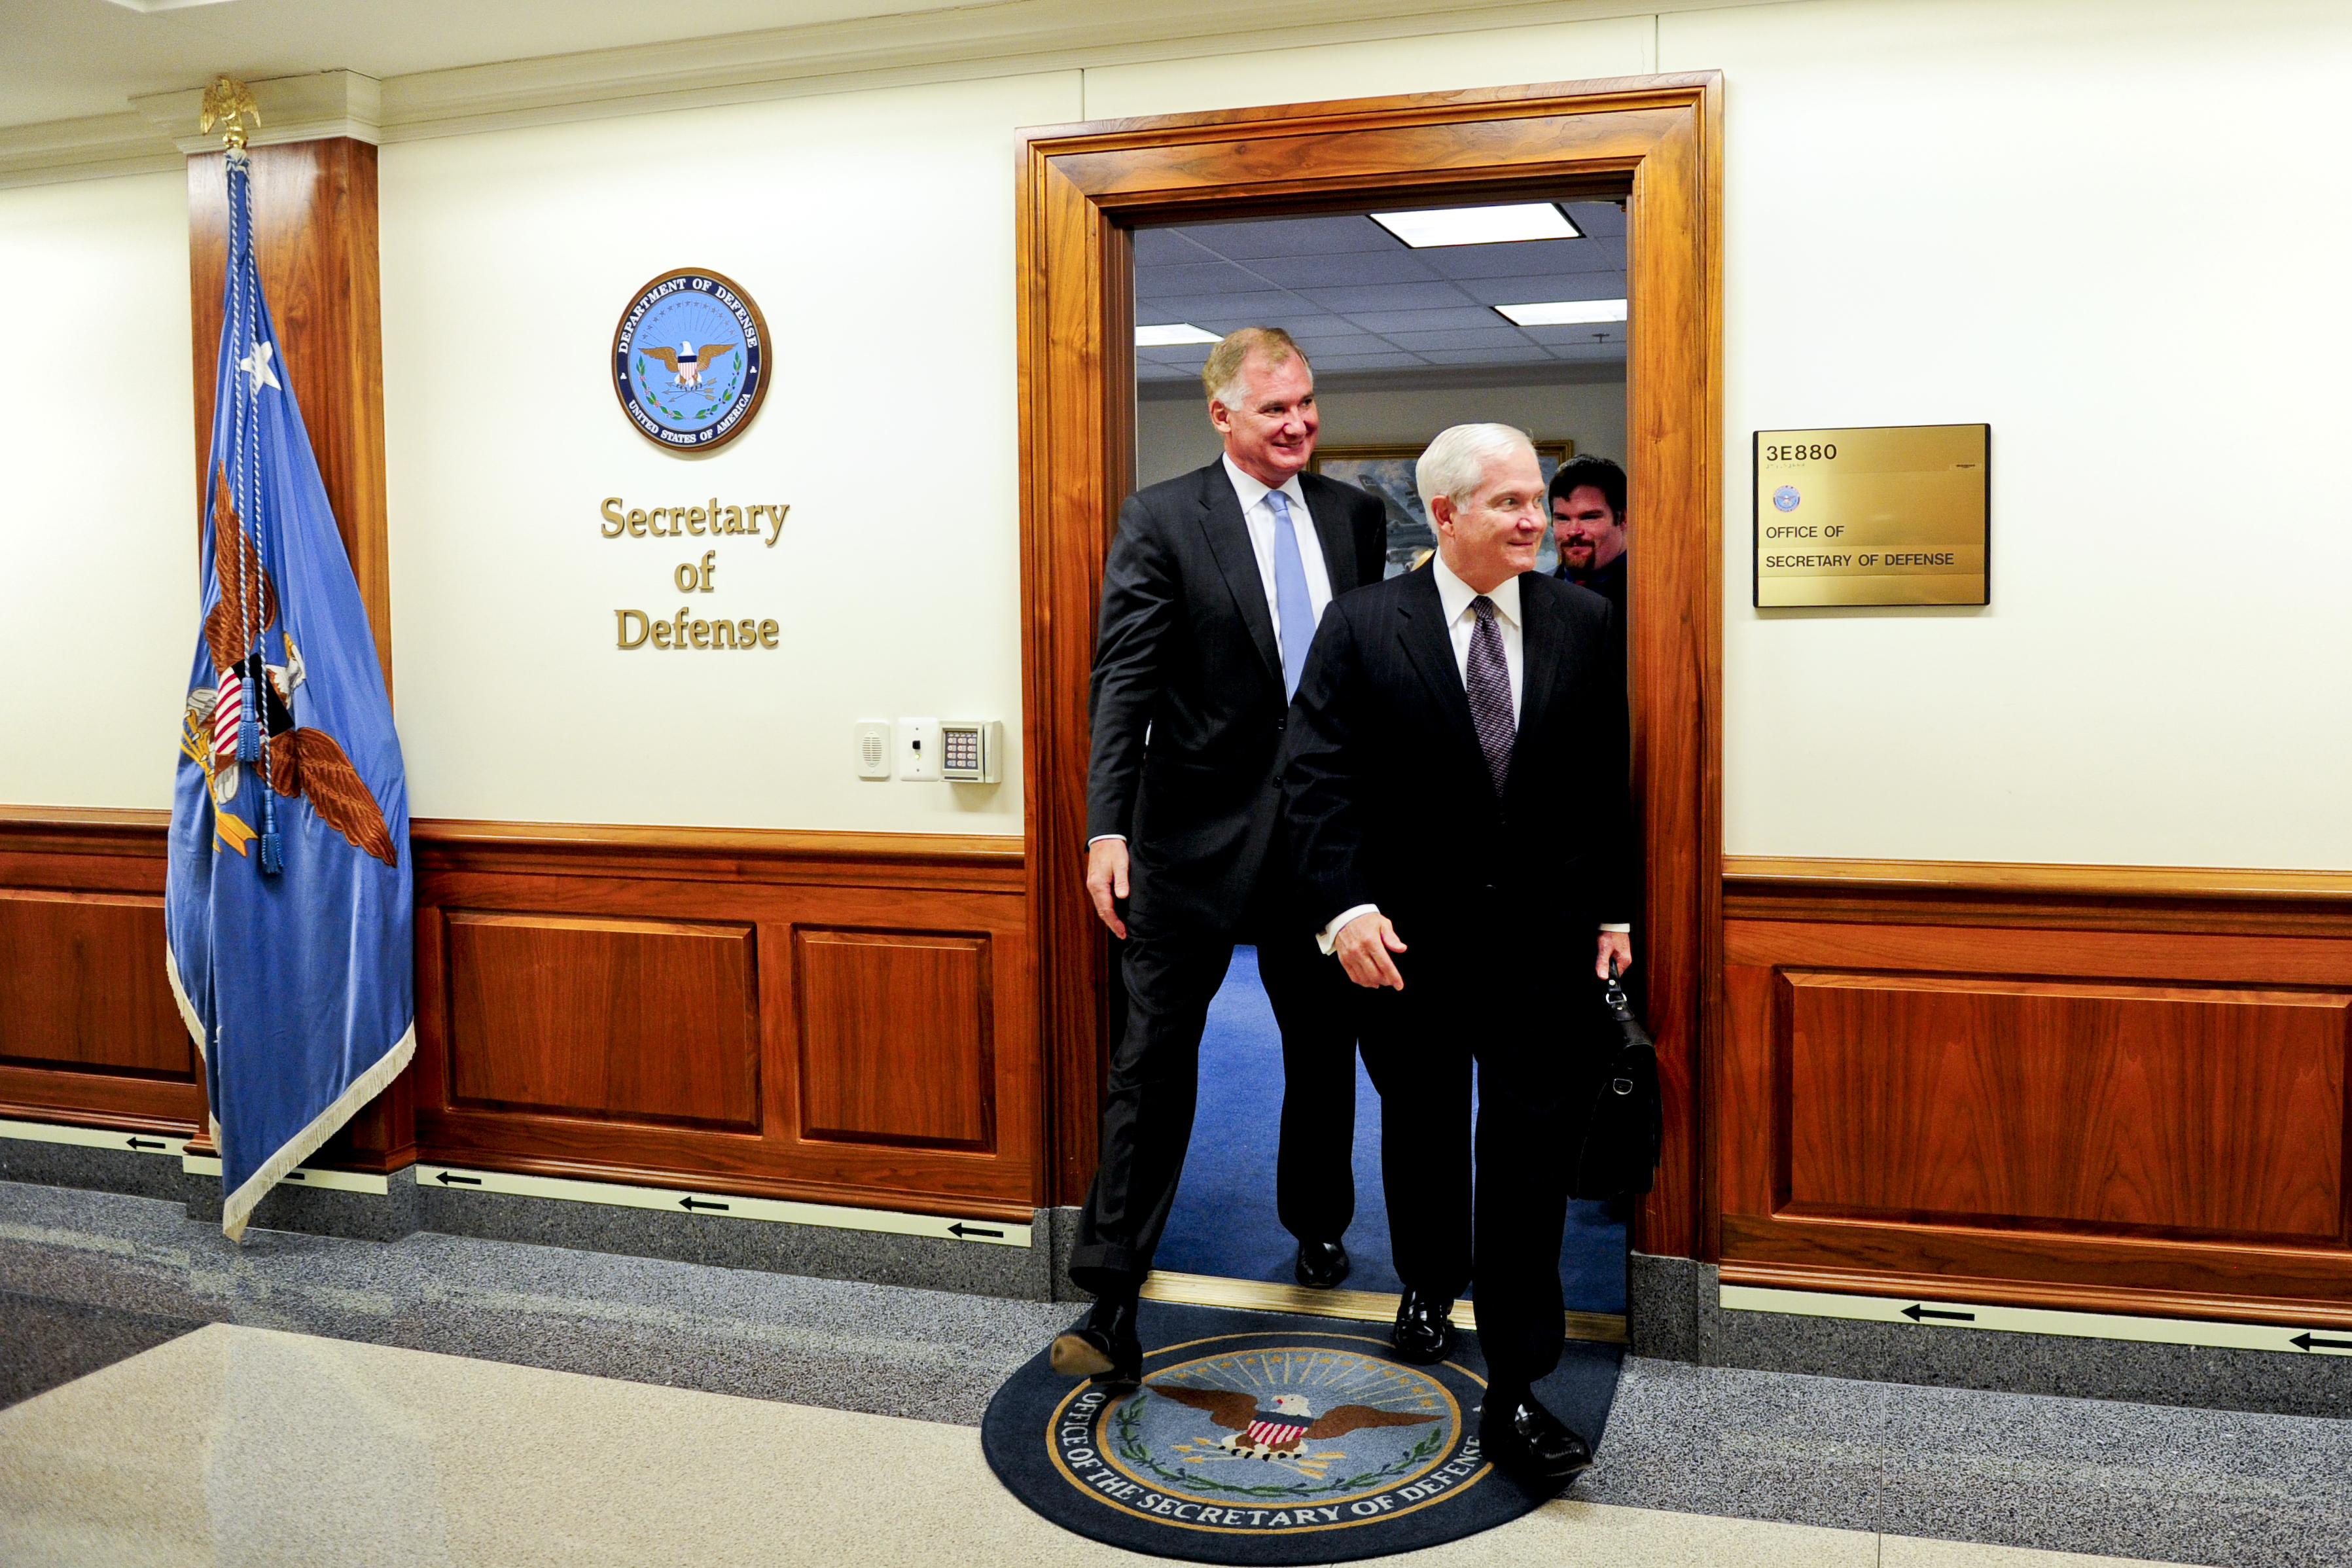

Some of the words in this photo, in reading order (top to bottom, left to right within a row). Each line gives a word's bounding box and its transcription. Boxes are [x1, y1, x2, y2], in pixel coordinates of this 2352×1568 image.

[618, 278, 686, 354] DEPARTMENT
[692, 278, 712, 291] OF
[715, 286, 758, 348] DEFENSE
[629, 399, 659, 434] UNITED
[660, 429, 696, 444] STATES
[700, 429, 714, 441] OF
[716, 393, 751, 434] AMERICA
[1766, 444, 1837, 461] 3E880
[600, 497, 790, 546] Secretary
[1766, 526, 1818, 539] OFFICE
[1824, 526, 1845, 538] OF
[674, 550, 716, 592] of
[1766, 554, 1852, 567] SECRETARY
[1858, 554, 1880, 566] OF
[1885, 553, 1955, 566] DEFENSE
[613, 606, 779, 649] Defense
[1061, 1392, 1107, 1447] OFFICE
[1067, 1448, 1103, 1469] OF
[1086, 1468, 1145, 1500] THE
[1136, 1493, 1340, 1526] SECRETARY
[1350, 1495, 1395, 1516] OF
